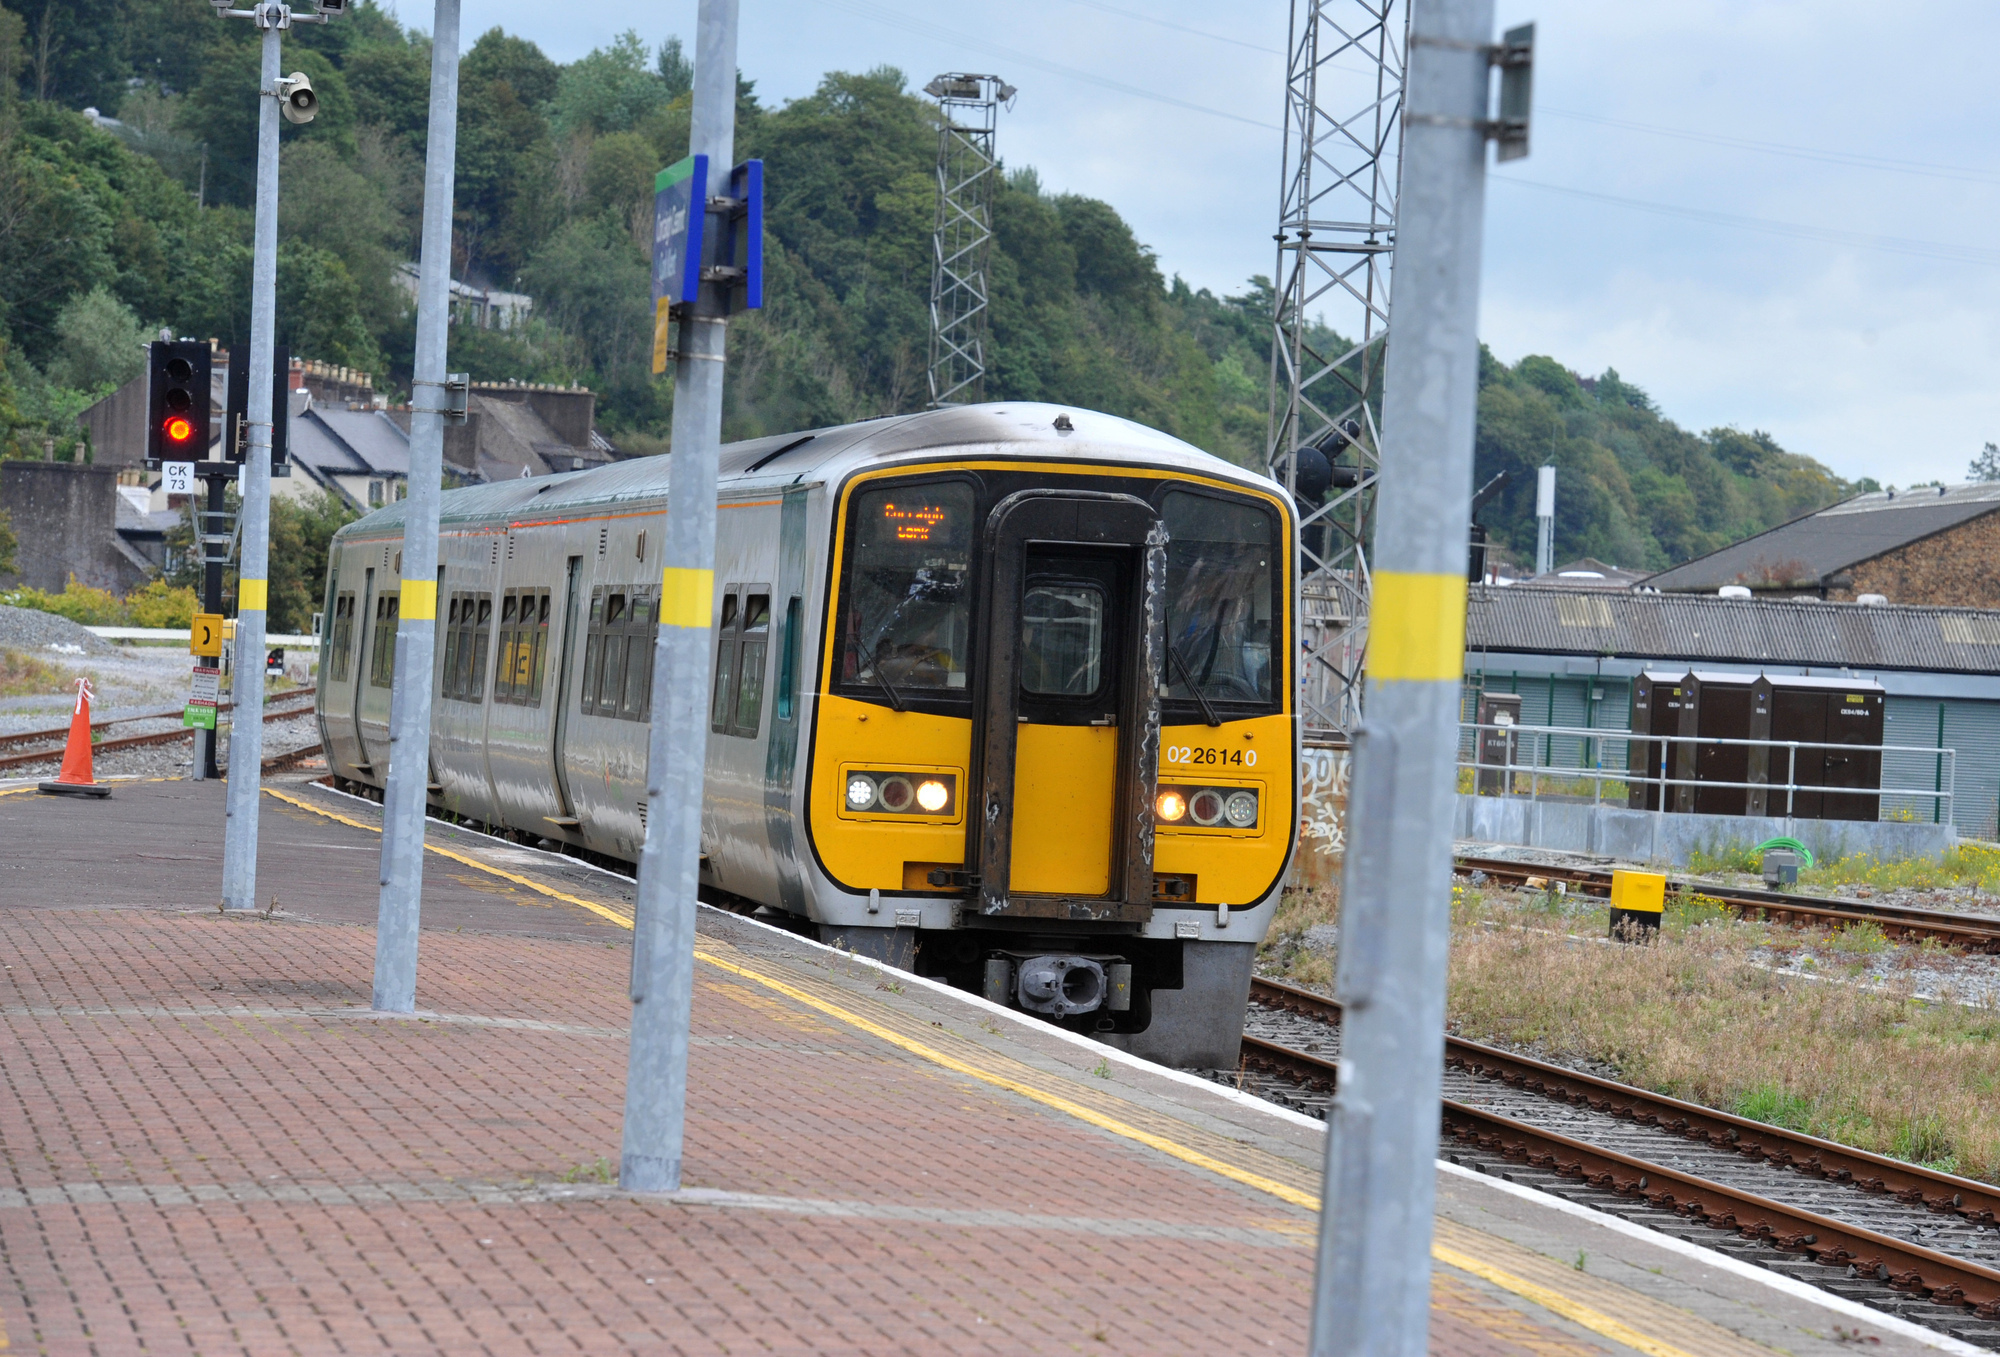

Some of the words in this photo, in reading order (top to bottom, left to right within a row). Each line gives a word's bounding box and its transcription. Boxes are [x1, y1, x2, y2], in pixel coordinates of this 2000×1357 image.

[168, 465, 187, 477] CK
[170, 479, 185, 490] 73
[194, 667, 219, 675] WARNING
[1167, 745, 1257, 767] 0226140
